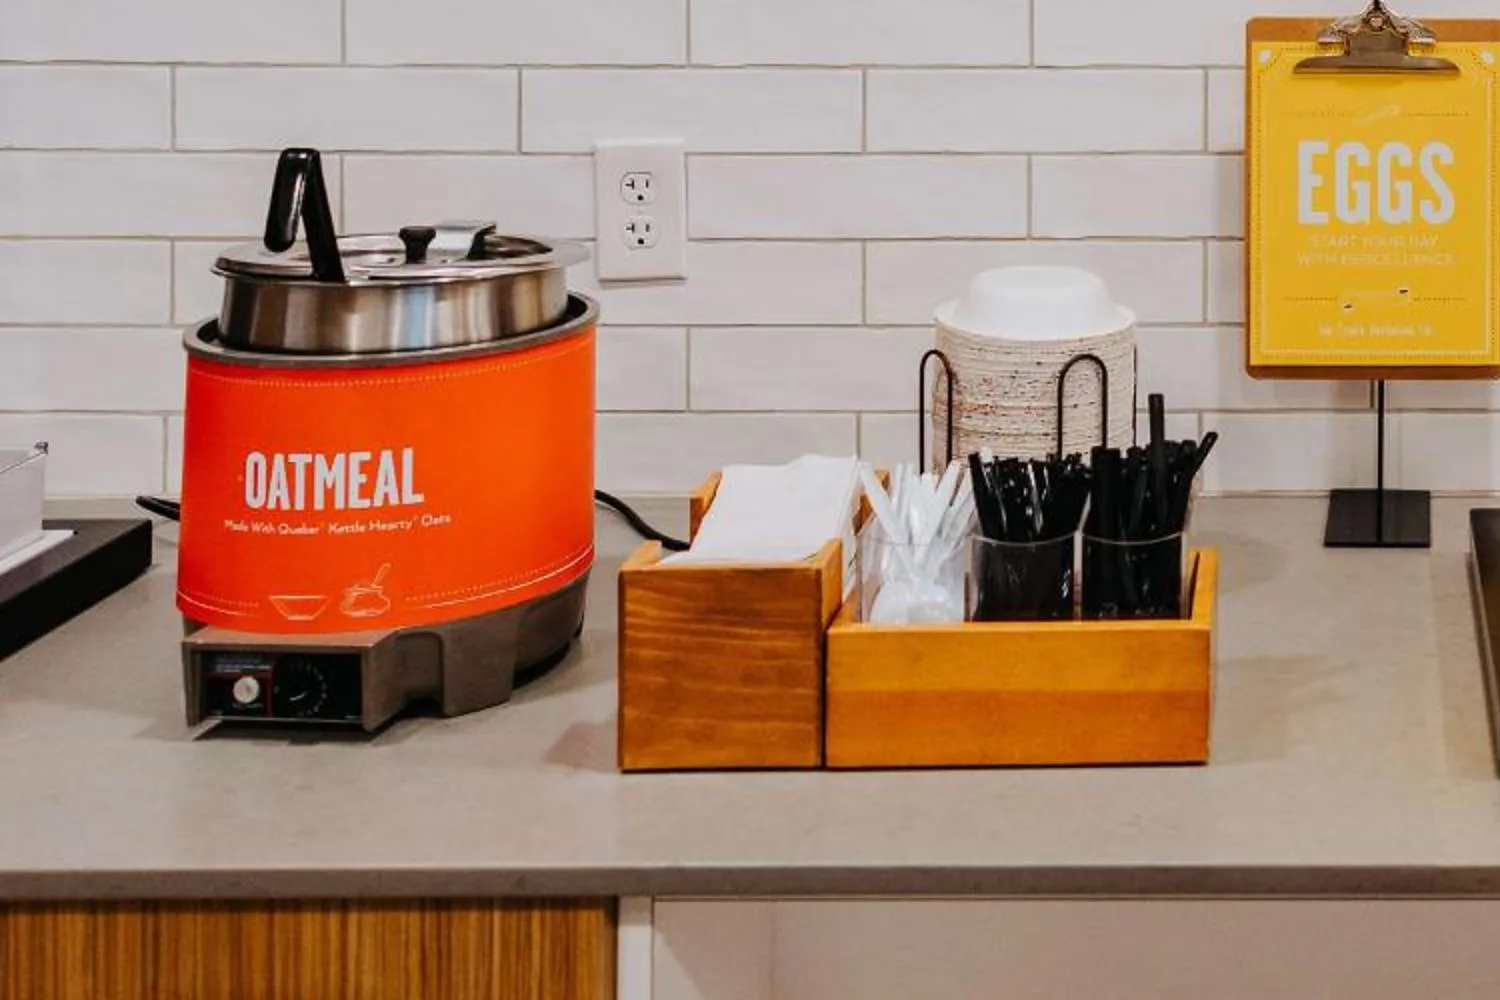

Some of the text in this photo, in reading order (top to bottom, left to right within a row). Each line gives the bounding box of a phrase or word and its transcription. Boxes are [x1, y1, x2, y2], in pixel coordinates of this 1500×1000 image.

[1297, 140, 1456, 226] EGGS
[244, 447, 425, 511] OATMEAL
[251, 520, 276, 535] With
[368, 517, 413, 533] Hearty
[420, 513, 452, 528] Oats
